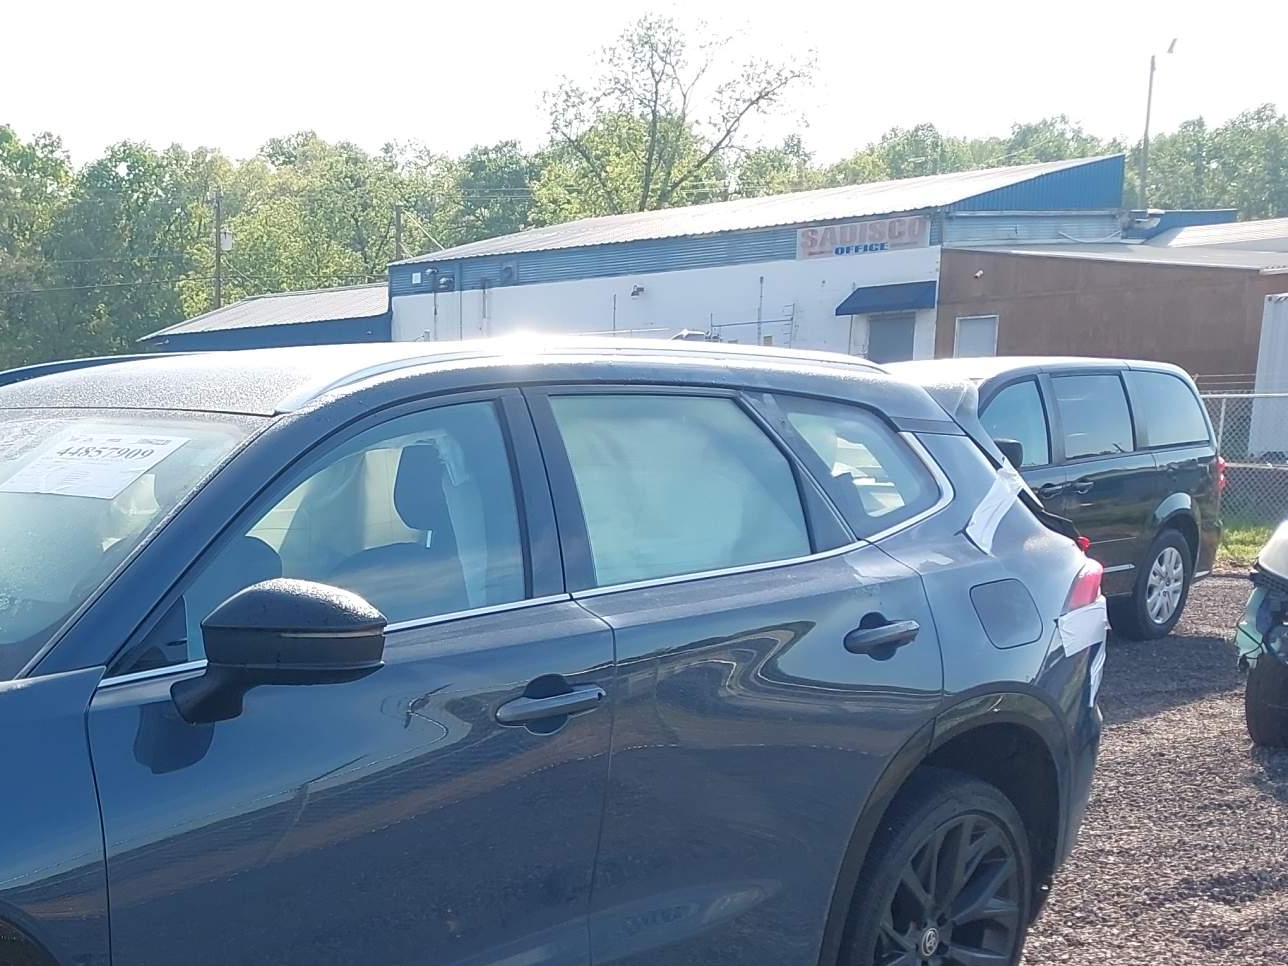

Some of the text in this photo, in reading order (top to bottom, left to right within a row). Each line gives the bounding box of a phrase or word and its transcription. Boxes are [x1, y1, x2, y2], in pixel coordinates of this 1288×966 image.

[803, 218, 924, 248] SADISCO
[834, 242, 889, 256] OFFICE
[56, 446, 155, 460] 44857909
